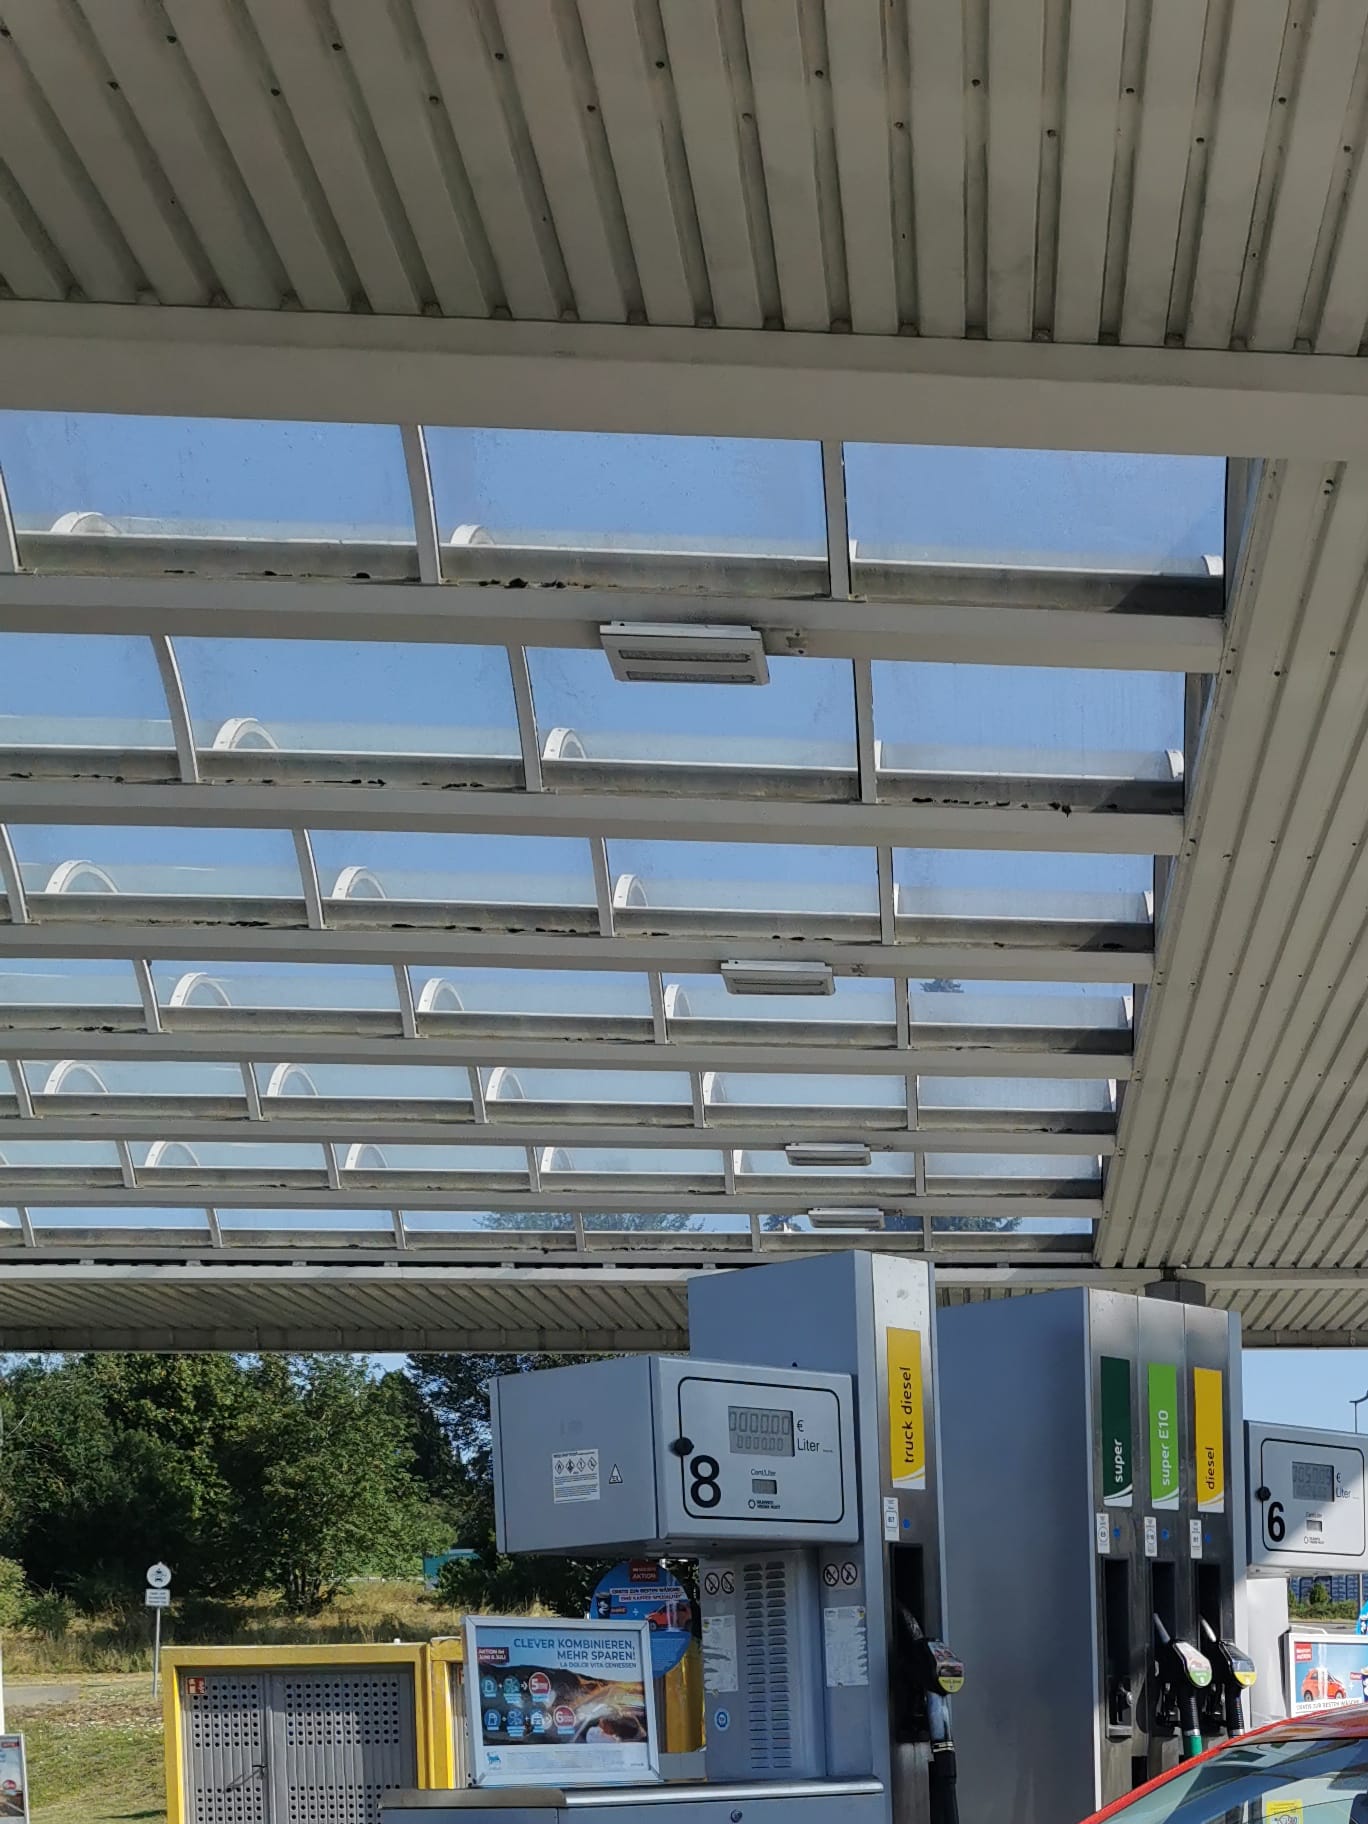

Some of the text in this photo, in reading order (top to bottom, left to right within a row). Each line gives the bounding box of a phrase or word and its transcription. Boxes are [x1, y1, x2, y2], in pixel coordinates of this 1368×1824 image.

[900, 1367, 914, 1463] truck diesel
[797, 1438, 820, 1452] Liter
[1114, 1438, 1125, 1483] super
[1158, 1410, 1172, 1486] super E10
[689, 1454, 721, 1508] 8
[1205, 1447, 1215, 1490] diesel
[1267, 1501, 1286, 1543] 6
[513, 1638, 635, 1651] CLEVER KOMBINIEREN,
[557, 1650, 636, 1661] MEHR SPAREN!
